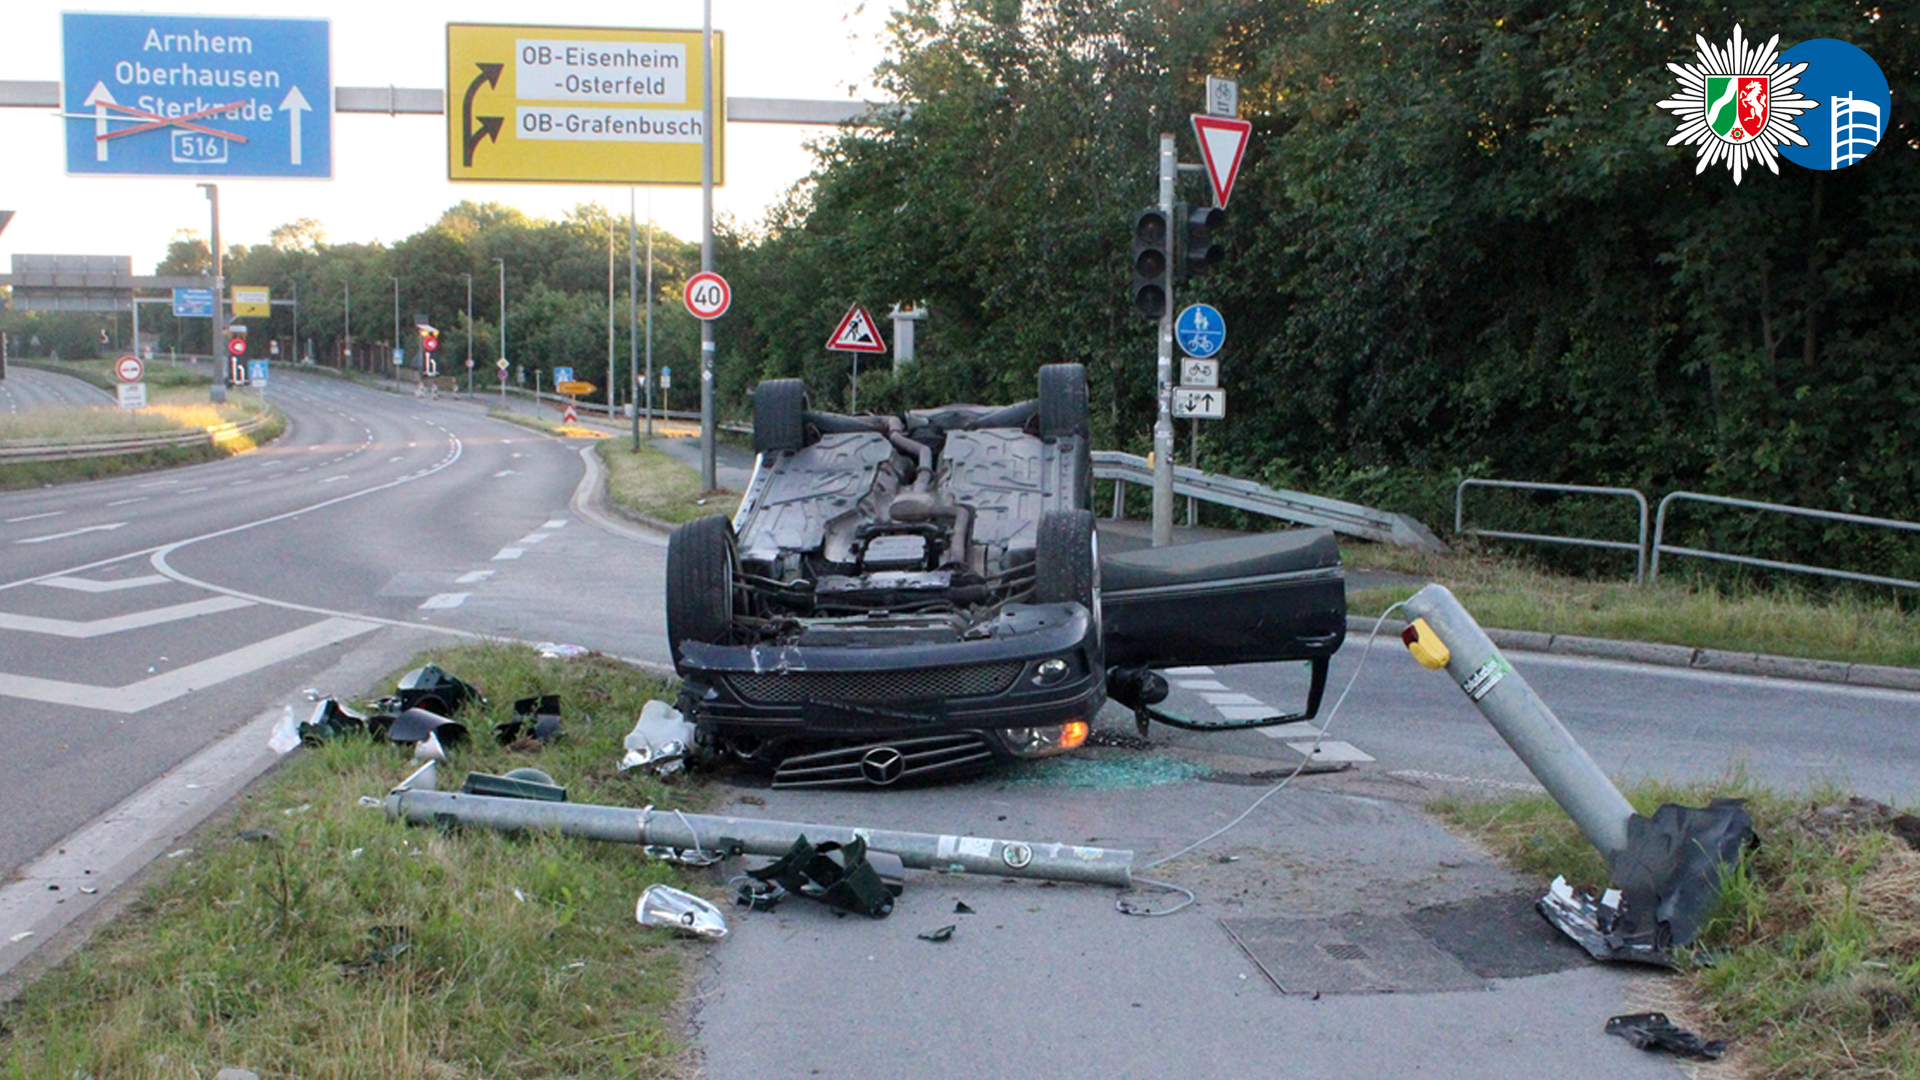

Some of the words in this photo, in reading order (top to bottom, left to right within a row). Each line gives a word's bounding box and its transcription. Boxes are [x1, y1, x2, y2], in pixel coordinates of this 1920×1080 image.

[143, 29, 252, 54] Arnhem
[522, 46, 679, 69] OB-Eisenheim
[115, 61, 280, 88] Oberhausen
[554, 75, 666, 95] -Osterfeld
[522, 114, 702, 136] OB-Grafenbusch
[181, 138, 218, 157] 516
[694, 286, 720, 306] 40
